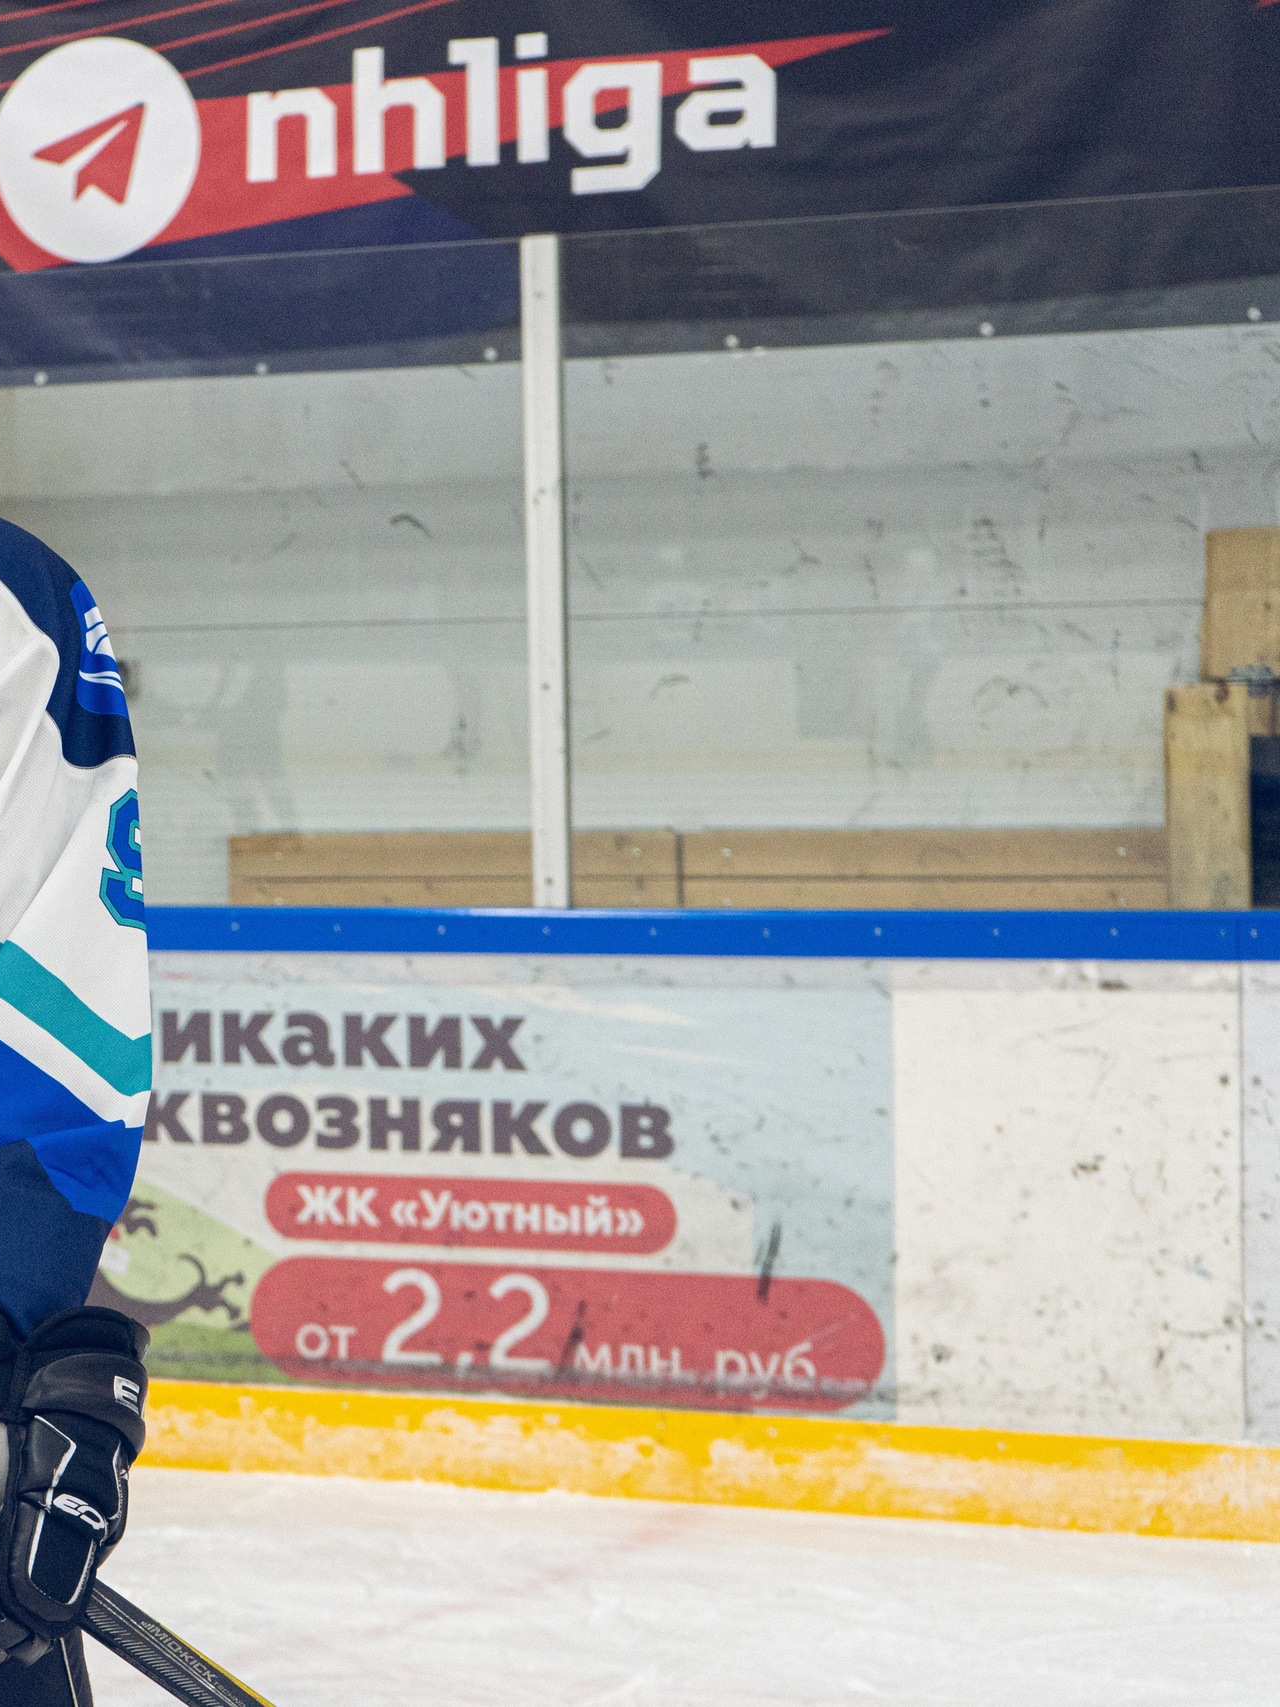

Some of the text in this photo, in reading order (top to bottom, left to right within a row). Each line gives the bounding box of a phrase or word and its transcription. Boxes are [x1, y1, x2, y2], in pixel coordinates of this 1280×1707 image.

[246, 32, 778, 195] nhliga
[159, 1008, 528, 1072] икаких
[143, 1090, 676, 1160] квозняков
[296, 1184, 380, 1228] ЖК
[295, 1323, 358, 1362] от
[382, 1268, 552, 1375] 2,2
